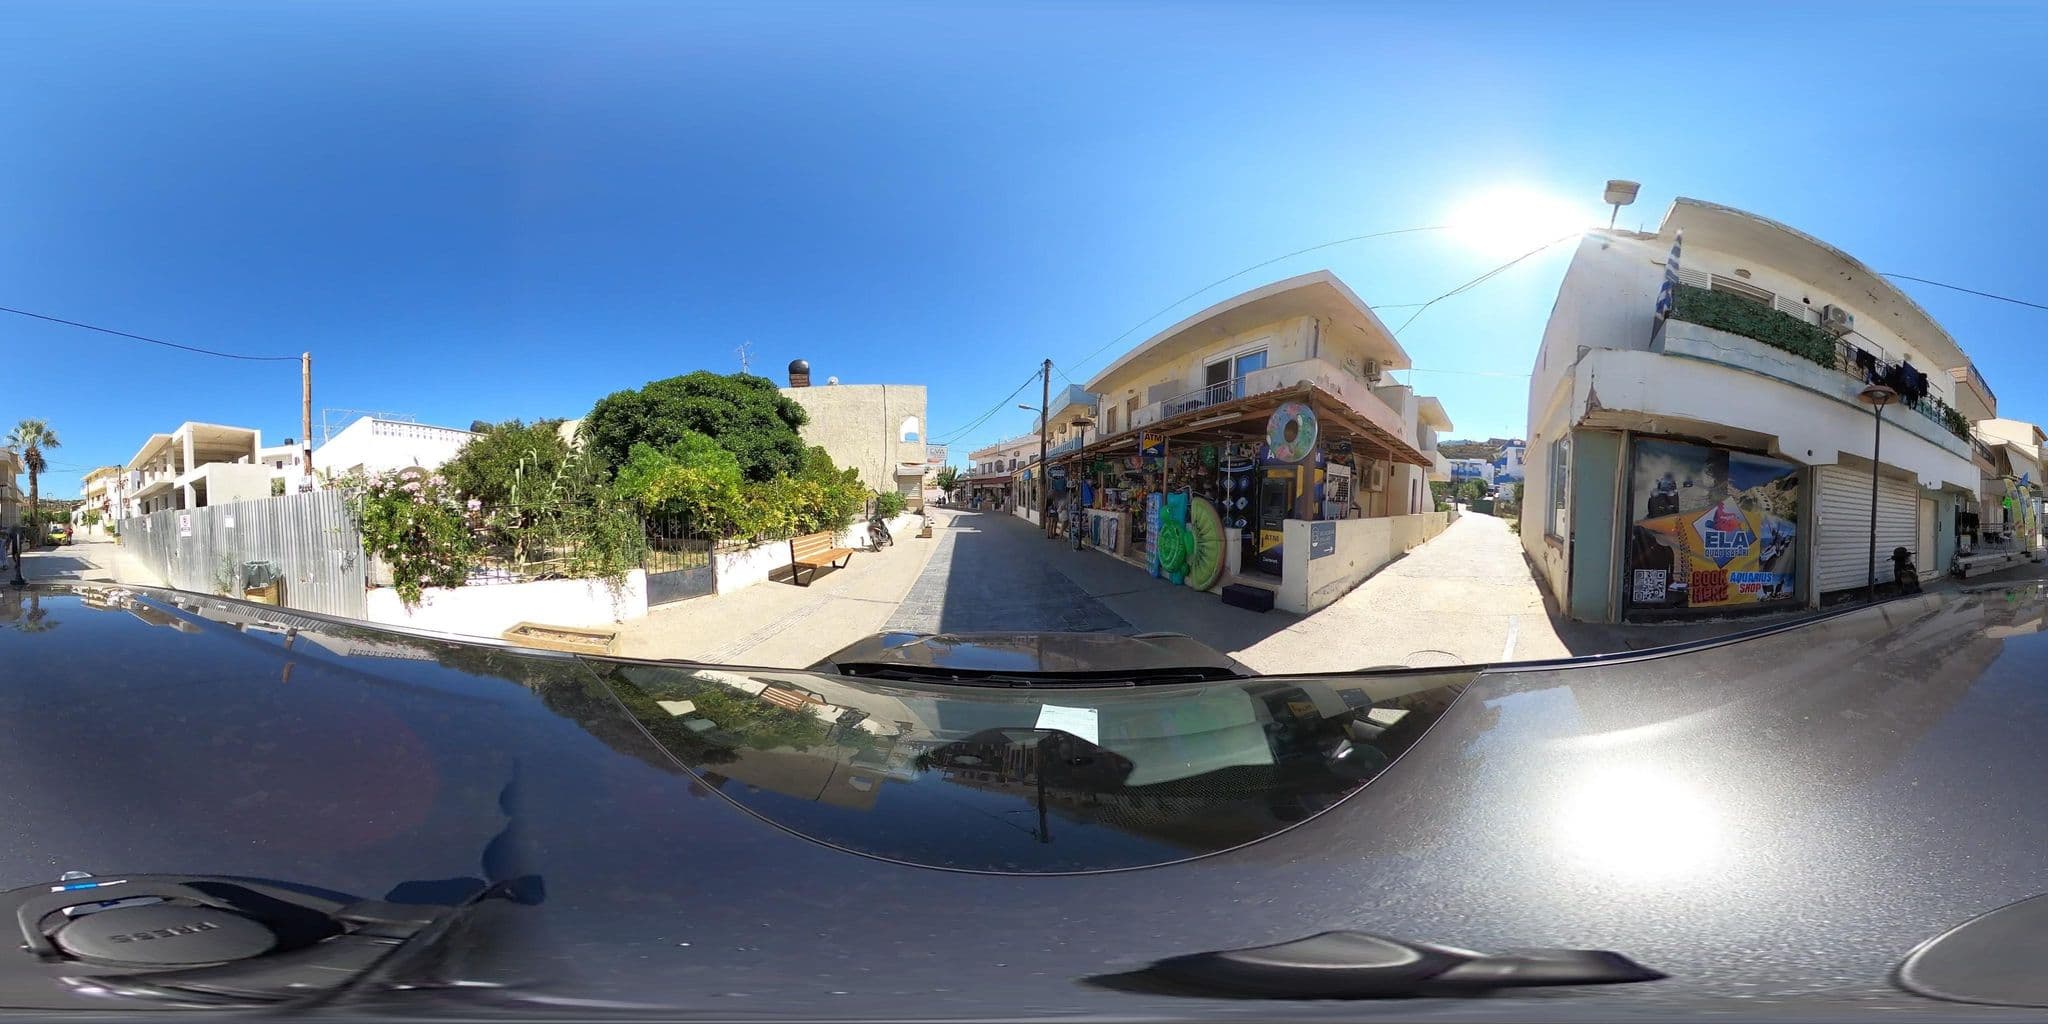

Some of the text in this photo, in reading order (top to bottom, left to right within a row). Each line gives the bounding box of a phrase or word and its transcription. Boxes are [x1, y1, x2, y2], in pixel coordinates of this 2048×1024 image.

[1145, 433, 1163, 442] ATM
[1265, 534, 1280, 542] ATM
[1705, 530, 1749, 549] ELA
[1693, 570, 1728, 587] BOOK
[1730, 572, 1772, 583] AQUARIUS
[1692, 586, 1728, 603] HERE
[1739, 583, 1761, 593] SHOP
[111, 922, 219, 943] PRESS
